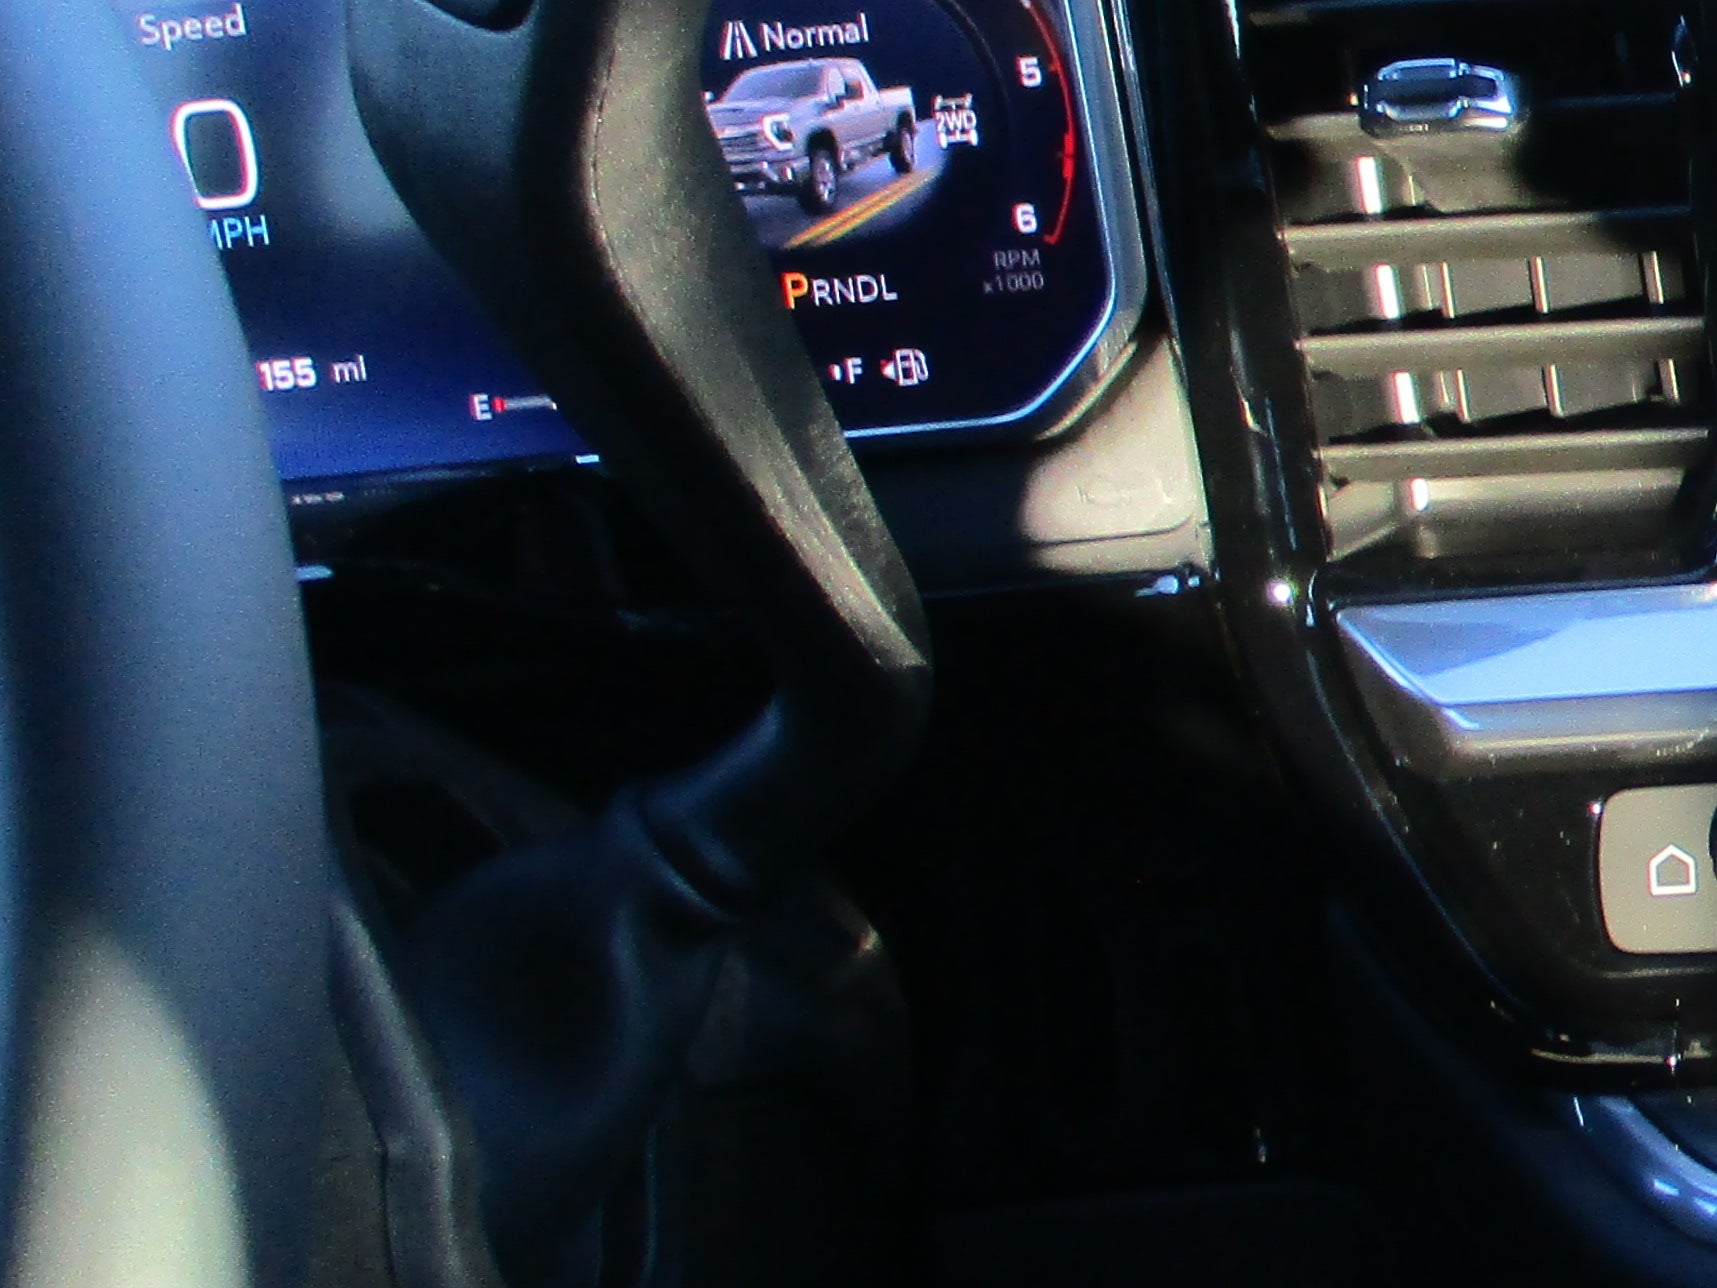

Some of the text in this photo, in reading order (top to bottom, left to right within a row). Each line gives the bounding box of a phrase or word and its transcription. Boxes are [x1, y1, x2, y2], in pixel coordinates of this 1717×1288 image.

[136, 3, 247, 51] Speed
[759, 12, 870, 51] Normal
[1015, 55, 1043, 88] 5
[935, 110, 978, 131] 2WD
[169, 98, 261, 210] 0
[1012, 202, 1039, 235] 6
[994, 249, 1041, 271] RPM
[983, 273, 1044, 295] x1000
[257, 357, 317, 392] 155
[844, 357, 863, 384] F
[470, 393, 493, 421] E
